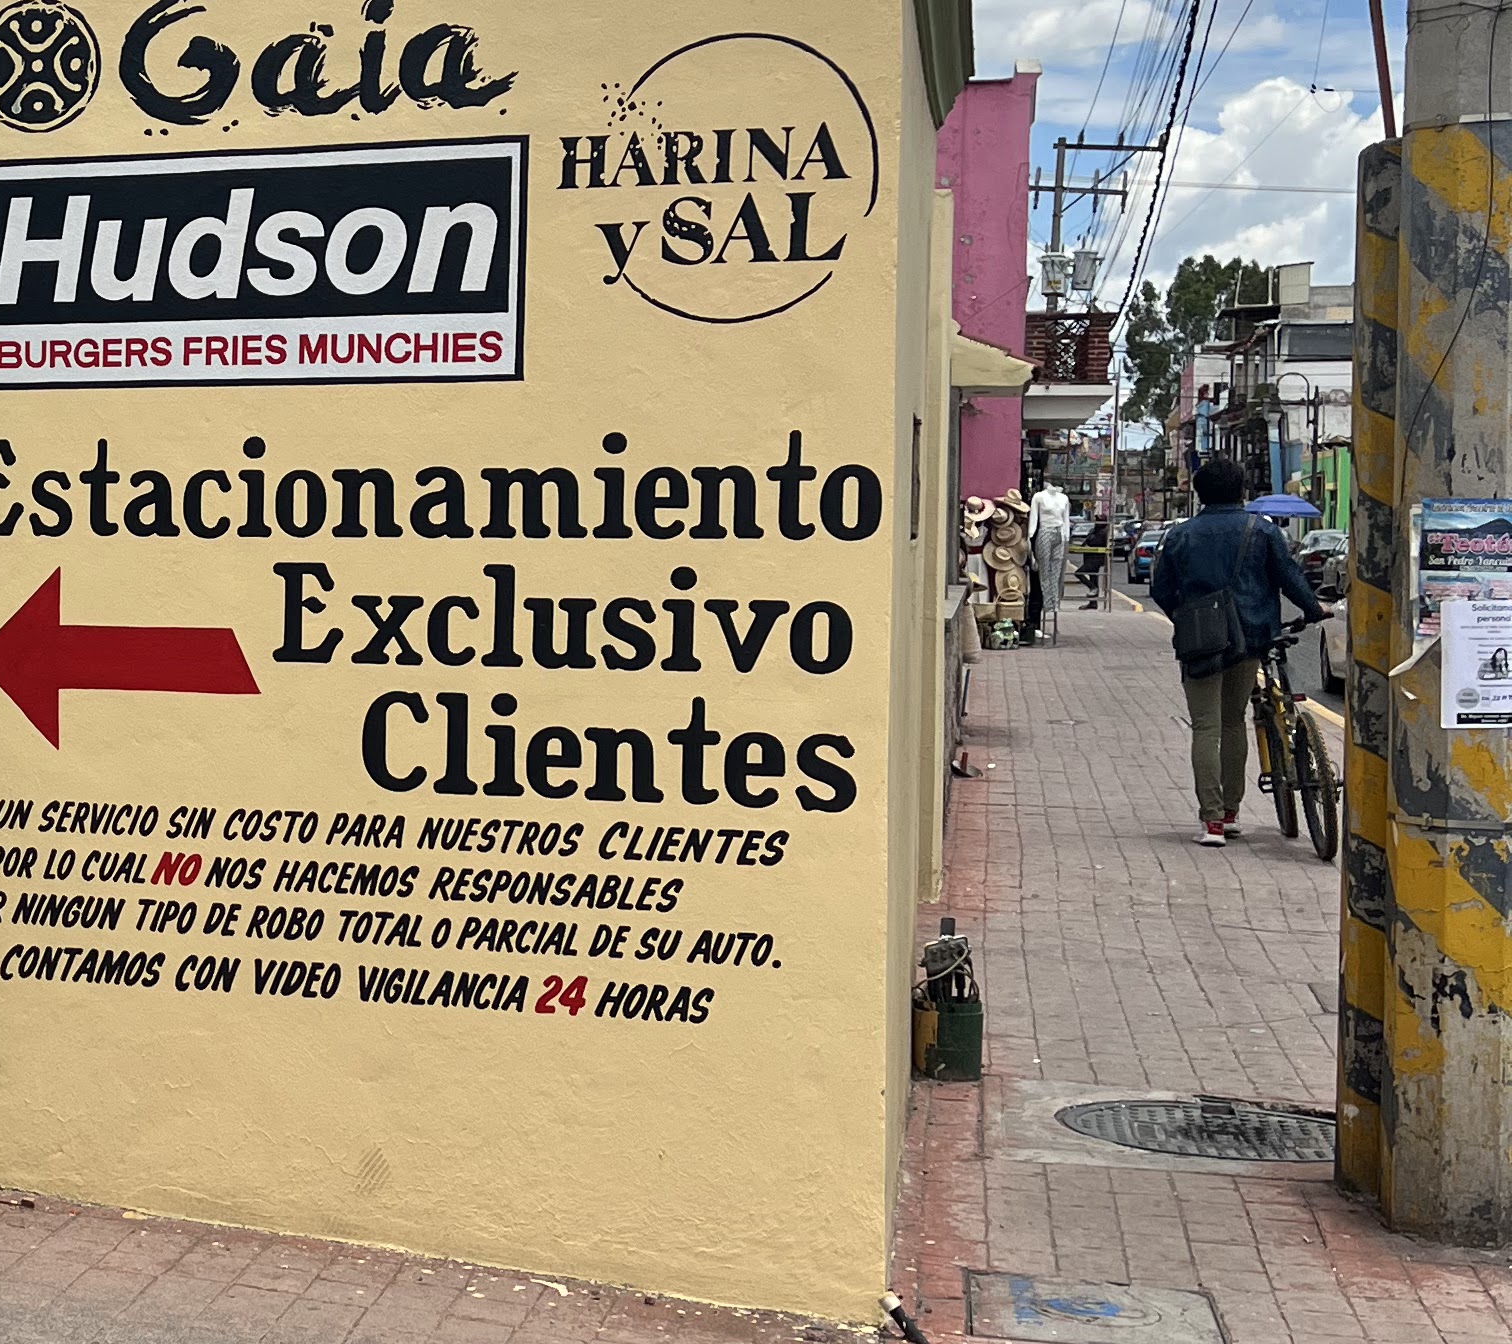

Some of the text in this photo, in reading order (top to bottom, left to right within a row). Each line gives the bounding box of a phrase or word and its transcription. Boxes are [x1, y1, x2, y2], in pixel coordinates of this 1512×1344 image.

[555, 120, 852, 191] HARINA
[593, 190, 848, 286] y SAL
[183, 335, 288, 366] FRIES
[299, 331, 502, 364] MUNCHIES
[272, 561, 854, 675] Exclusivo
[361, 690, 857, 813] Clientes
[37, 799, 159, 837] SERVICIO
[165, 805, 217, 840] SIN
[223, 808, 319, 844] COSTO
[325, 812, 406, 849] PARA
[416, 817, 585, 857] NUESTROS
[598, 821, 790, 867] CLIENTES
[42, 848, 76, 881] LO
[81, 849, 148, 884] CUAL
[150, 851, 203, 887] NO
[203, 856, 267, 890] NOS
[272, 859, 420, 898] HACEMOS
[427, 866, 684, 913] RESPONSABLES
[11, 892, 126, 931] NINGUN
[135, 898, 198, 935] TIPO
[202, 902, 242, 937] DE
[245, 905, 325, 941] ROBO
[338, 909, 423, 948] TOTAL
[431, 917, 452, 949] O
[455, 916, 578, 957] PARCIAL
[587, 923, 632, 959] DE
[634, 927, 683, 961] SU
[686, 929, 782, 969] AUTO.
[0, 943, 715, 1024] CONTAMOS CON VIDEO VIGILANCIA 24 HORAS
